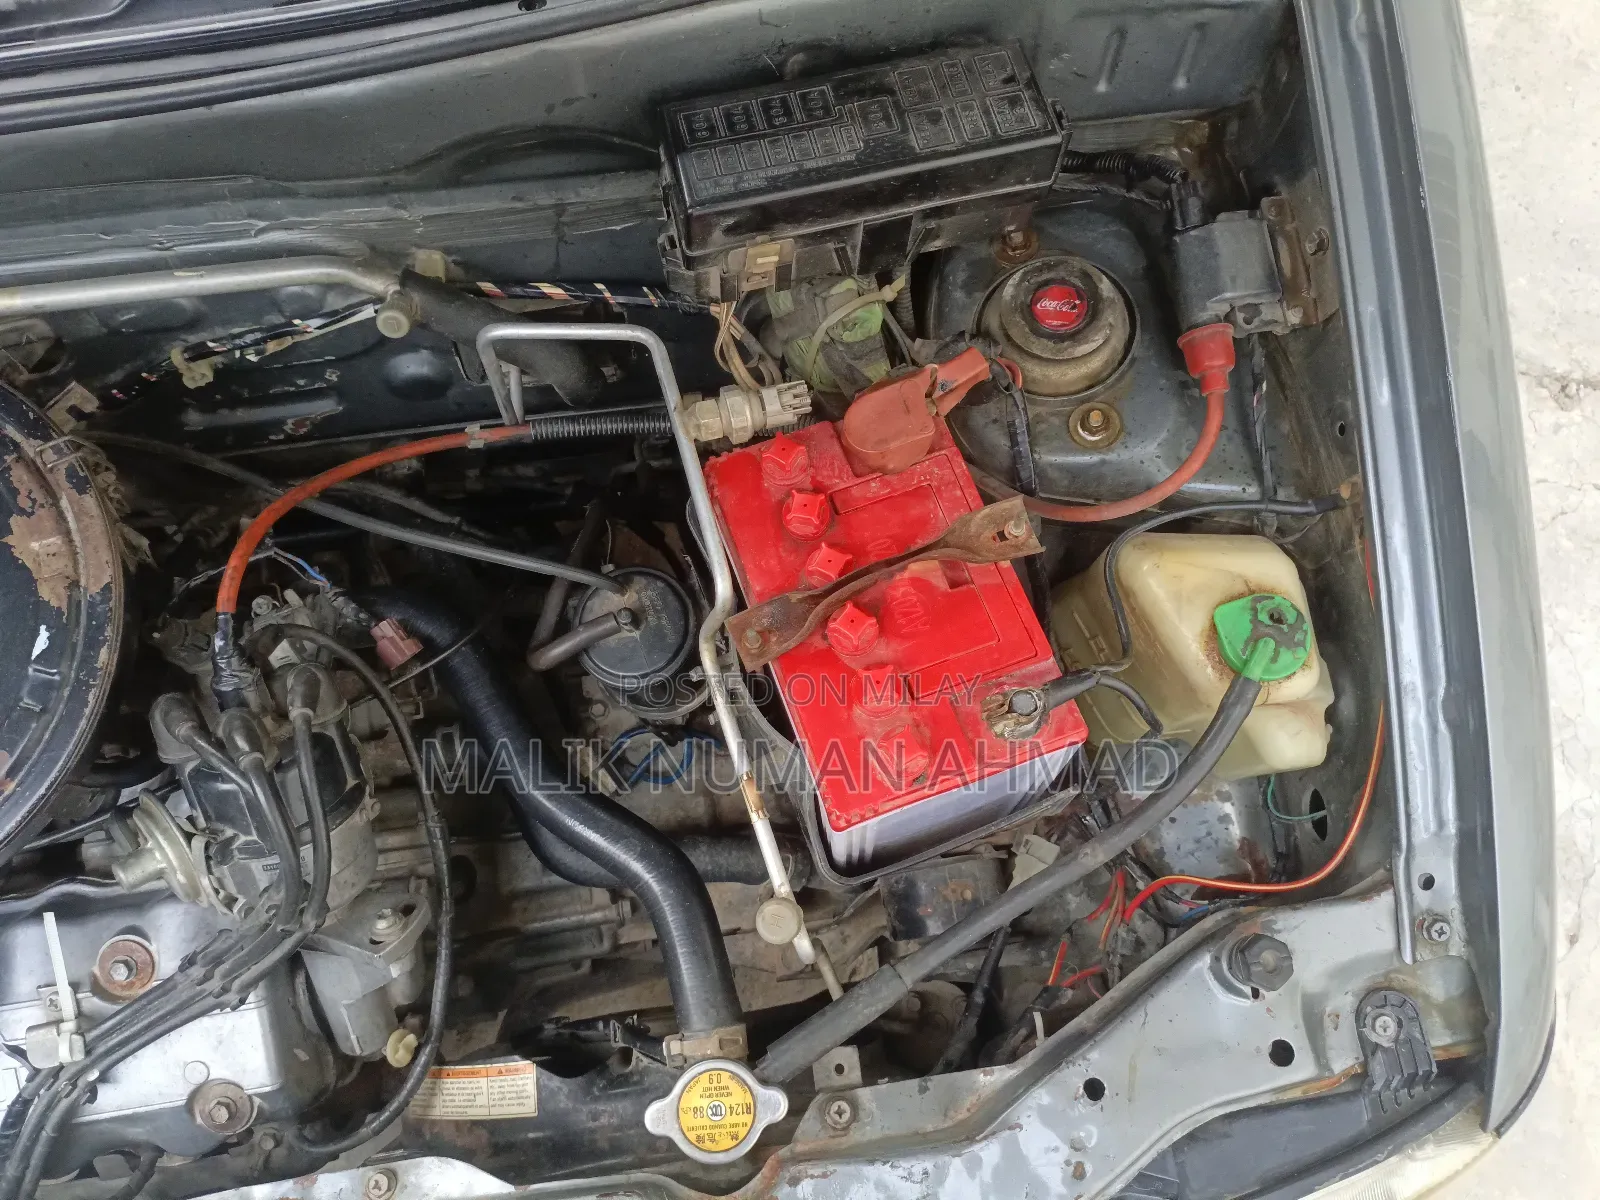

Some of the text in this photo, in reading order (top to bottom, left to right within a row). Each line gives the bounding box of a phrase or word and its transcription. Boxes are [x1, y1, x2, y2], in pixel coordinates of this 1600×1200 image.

[685, 1077, 701, 1094] JAPAN
[708, 1073, 722, 1084] 0.9
[692, 1106, 705, 1119] 88
[729, 1102, 752, 1117] R124
